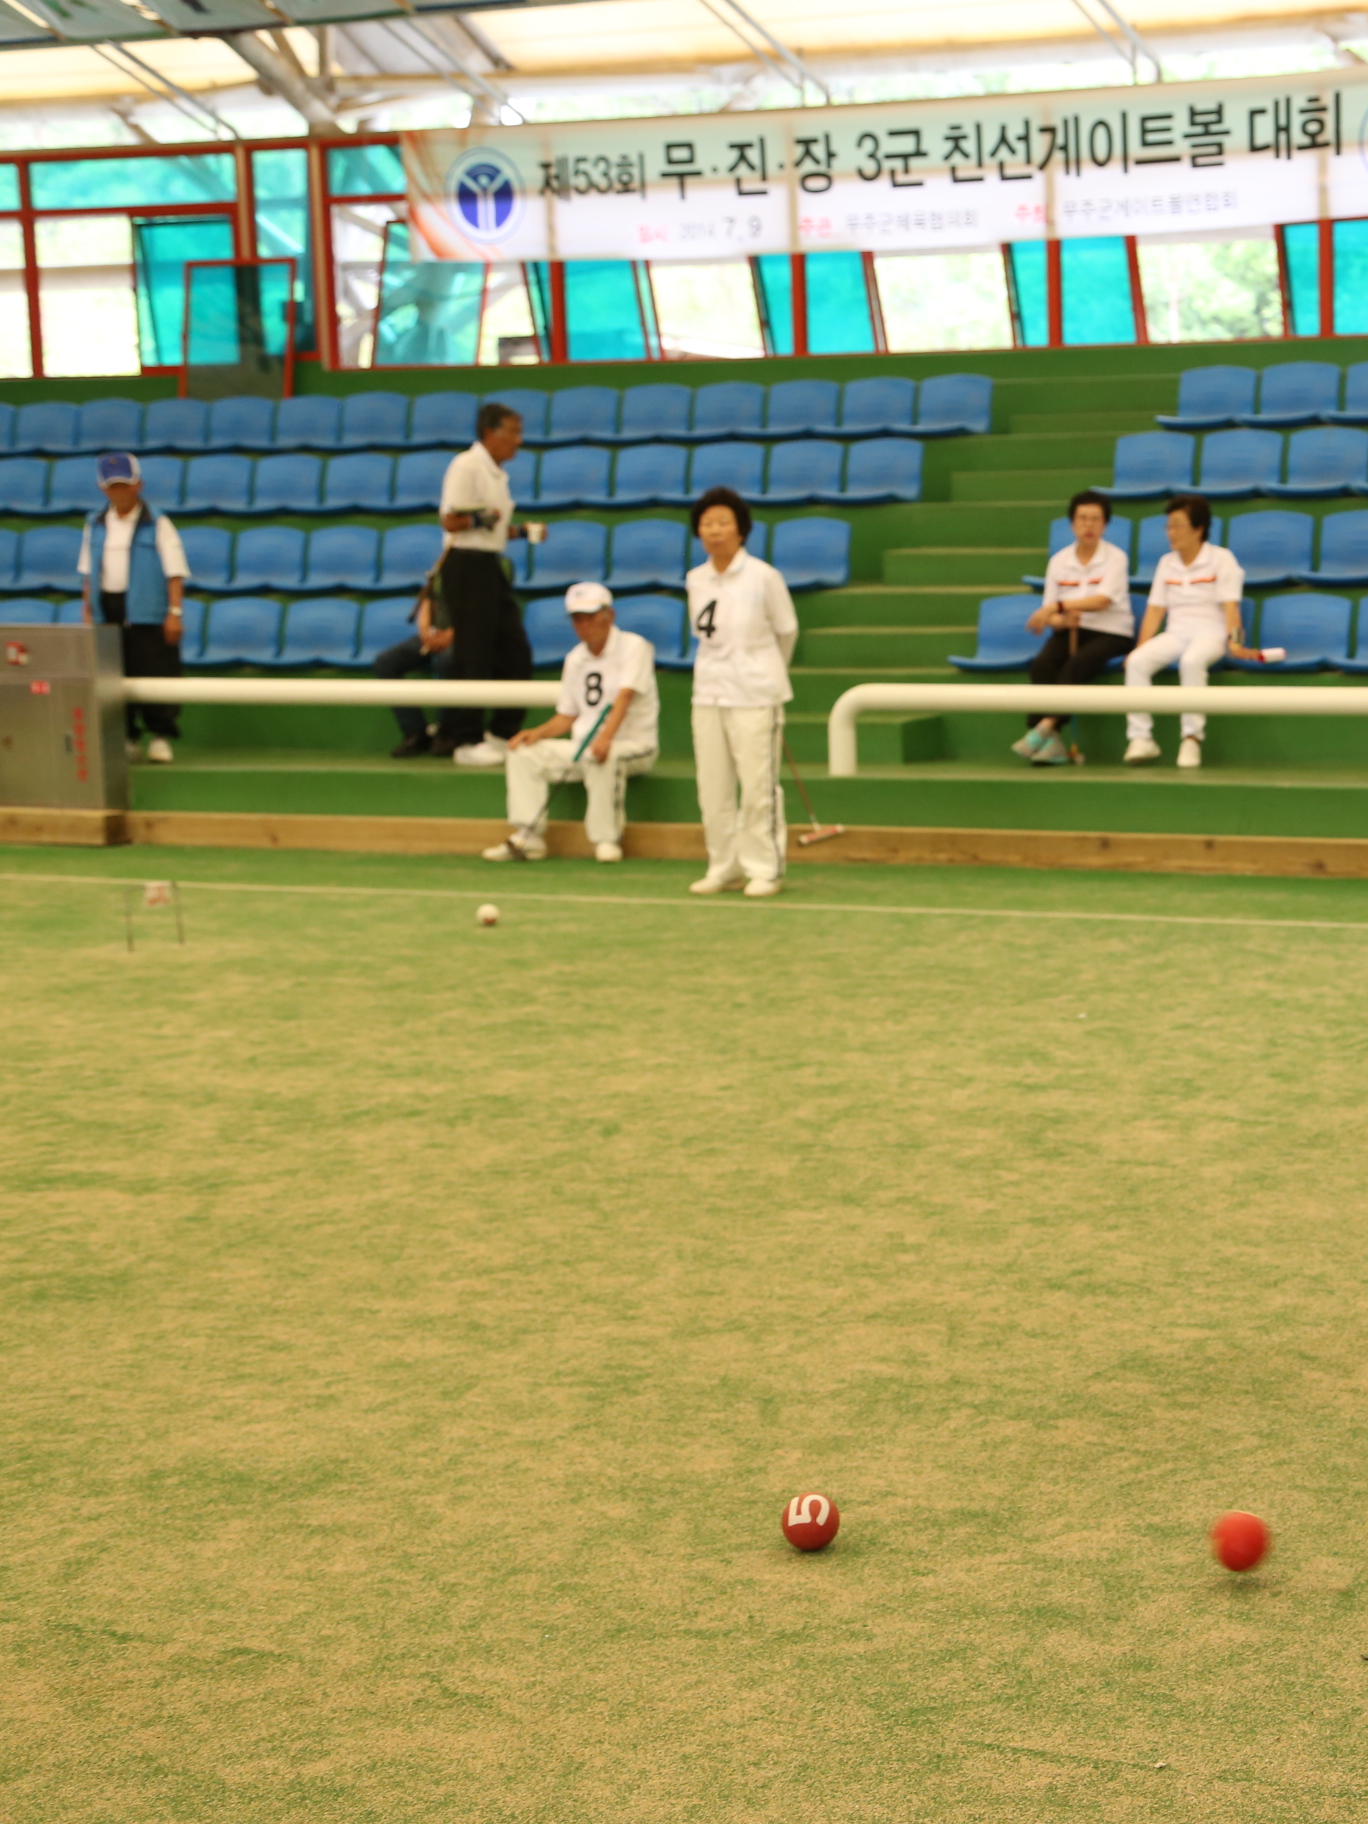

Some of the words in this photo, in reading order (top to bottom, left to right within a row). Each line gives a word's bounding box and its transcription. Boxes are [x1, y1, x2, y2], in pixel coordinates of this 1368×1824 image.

[539, 152, 647, 200] 제53회
[1248, 91, 1343, 160] 대회
[697, 599, 717, 639] 4
[585, 672, 603, 707] 8
[788, 1494, 830, 1527] 5
